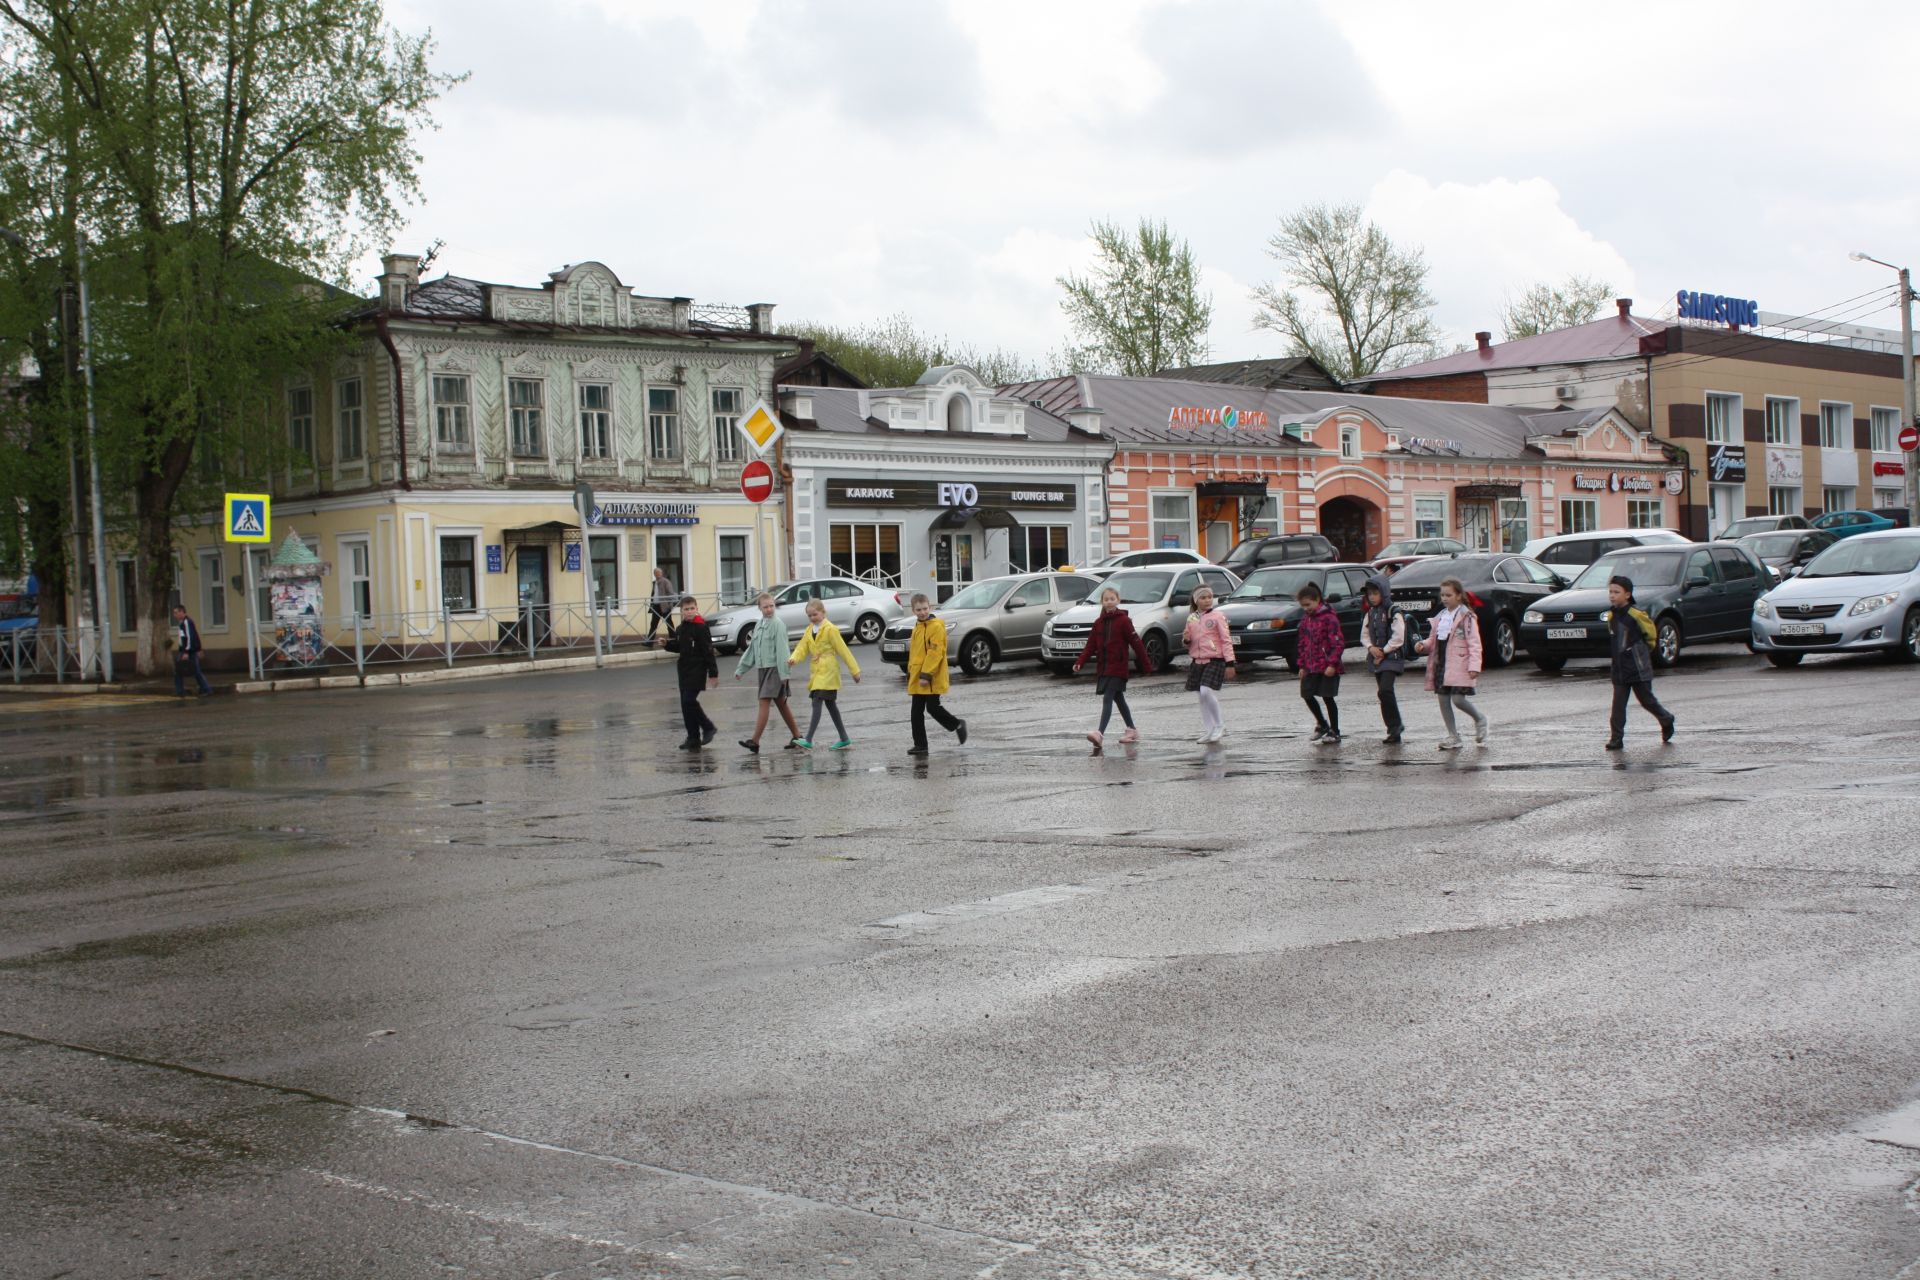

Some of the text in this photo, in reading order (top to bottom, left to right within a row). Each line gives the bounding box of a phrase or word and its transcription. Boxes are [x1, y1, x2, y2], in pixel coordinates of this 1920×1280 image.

[1677, 289, 1758, 327] SAMSUNG
[1168, 407, 1268, 426] АПТЕКА ВИТА
[1575, 474, 1653, 492] Пекарня Добропек
[846, 482, 1065, 507] KARAOKE EVO LOUNGE BAR
